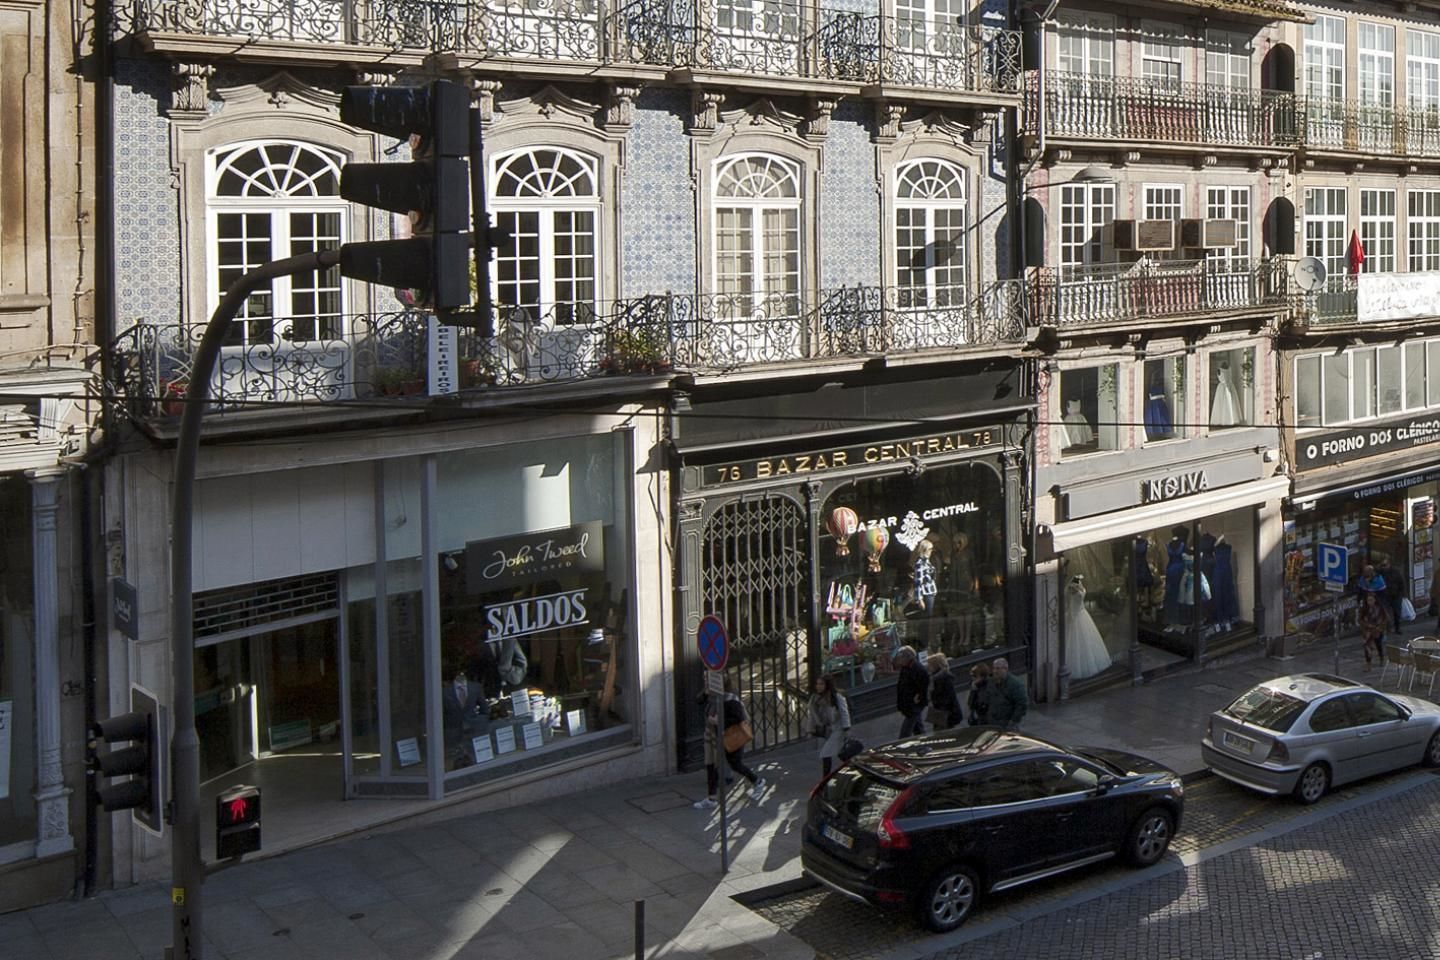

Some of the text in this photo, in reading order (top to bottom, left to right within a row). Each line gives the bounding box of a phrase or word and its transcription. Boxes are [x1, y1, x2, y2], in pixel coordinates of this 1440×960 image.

[717, 431, 991, 483] 76 BAZAR CENTRAL 78
[1306, 444, 1318, 459] O
[1321, 435, 1365, 456] FORNO
[1369, 429, 1392, 446] DOS
[1146, 470, 1209, 502] NOIVA
[1360, 486, 1382, 498] FORNO
[1383, 482, 1395, 492] DOS
[847, 501, 979, 535] BAZAR CENTRAL
[482, 532, 589, 579] John Tweed
[511, 561, 572, 577] TAILORED
[1323, 547, 1341, 577] P
[486, 592, 587, 639] SALDOS
